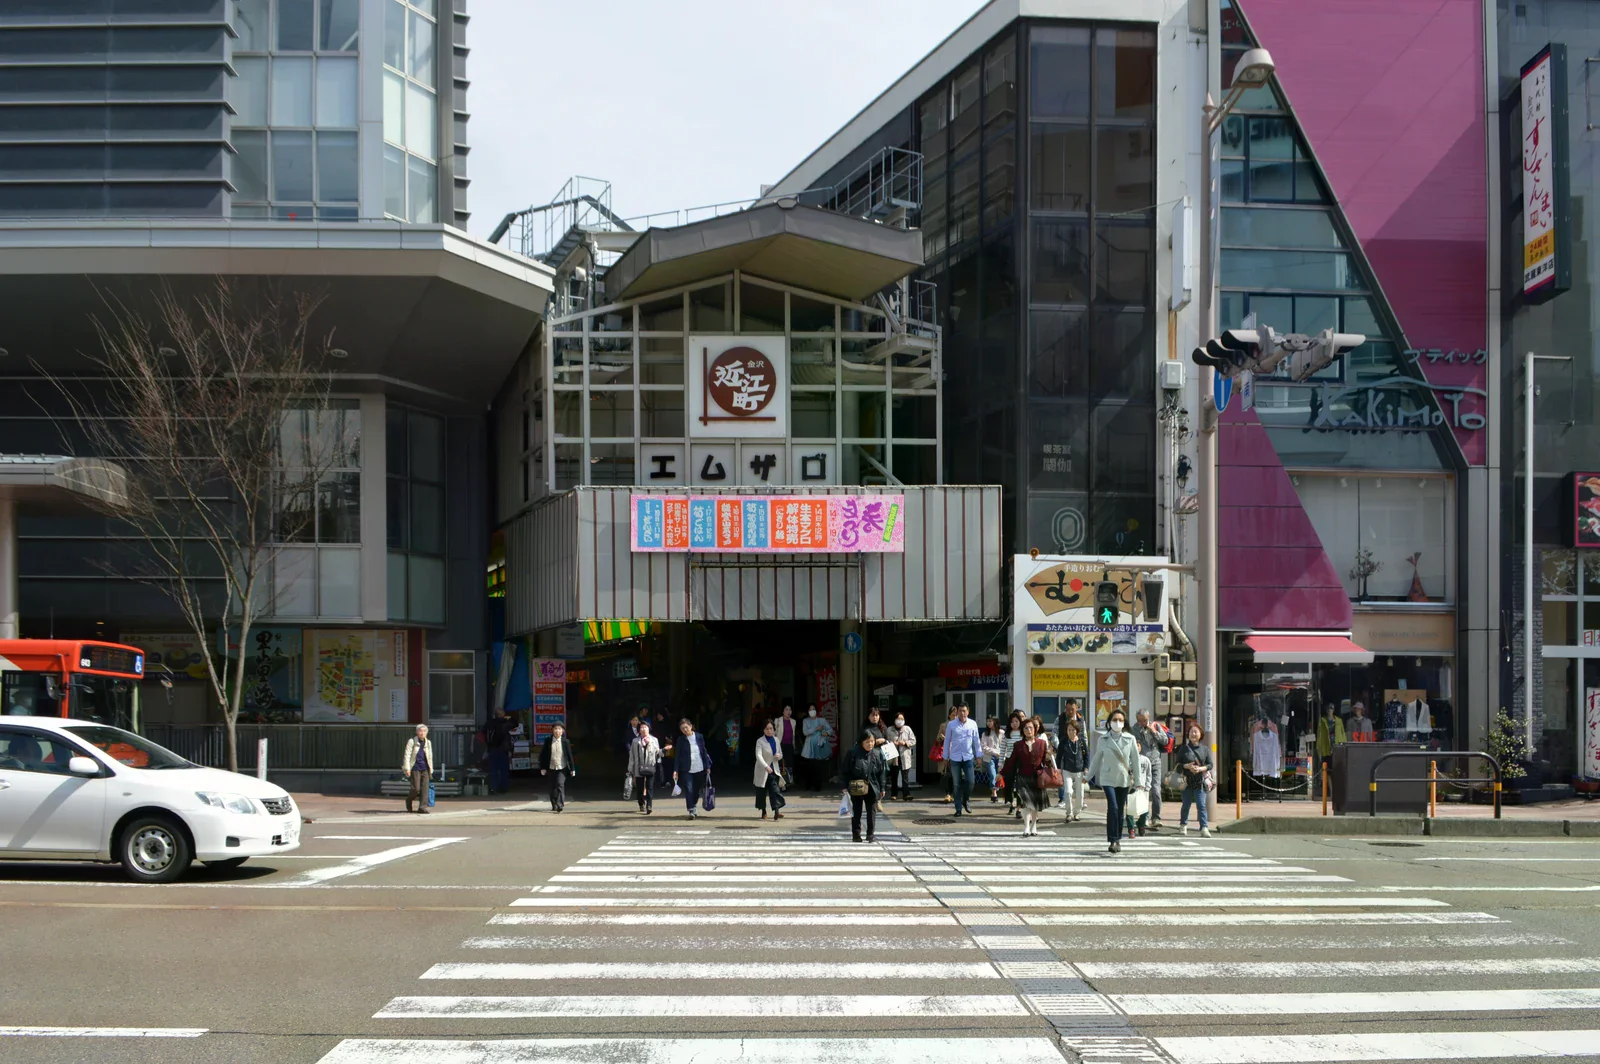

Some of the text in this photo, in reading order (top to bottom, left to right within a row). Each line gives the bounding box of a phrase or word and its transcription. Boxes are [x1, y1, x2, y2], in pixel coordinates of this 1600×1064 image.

[747, 360, 765, 369] 金沢
[1403, 348, 1488, 365] ブティック
[713, 360, 770, 412] 近江町
